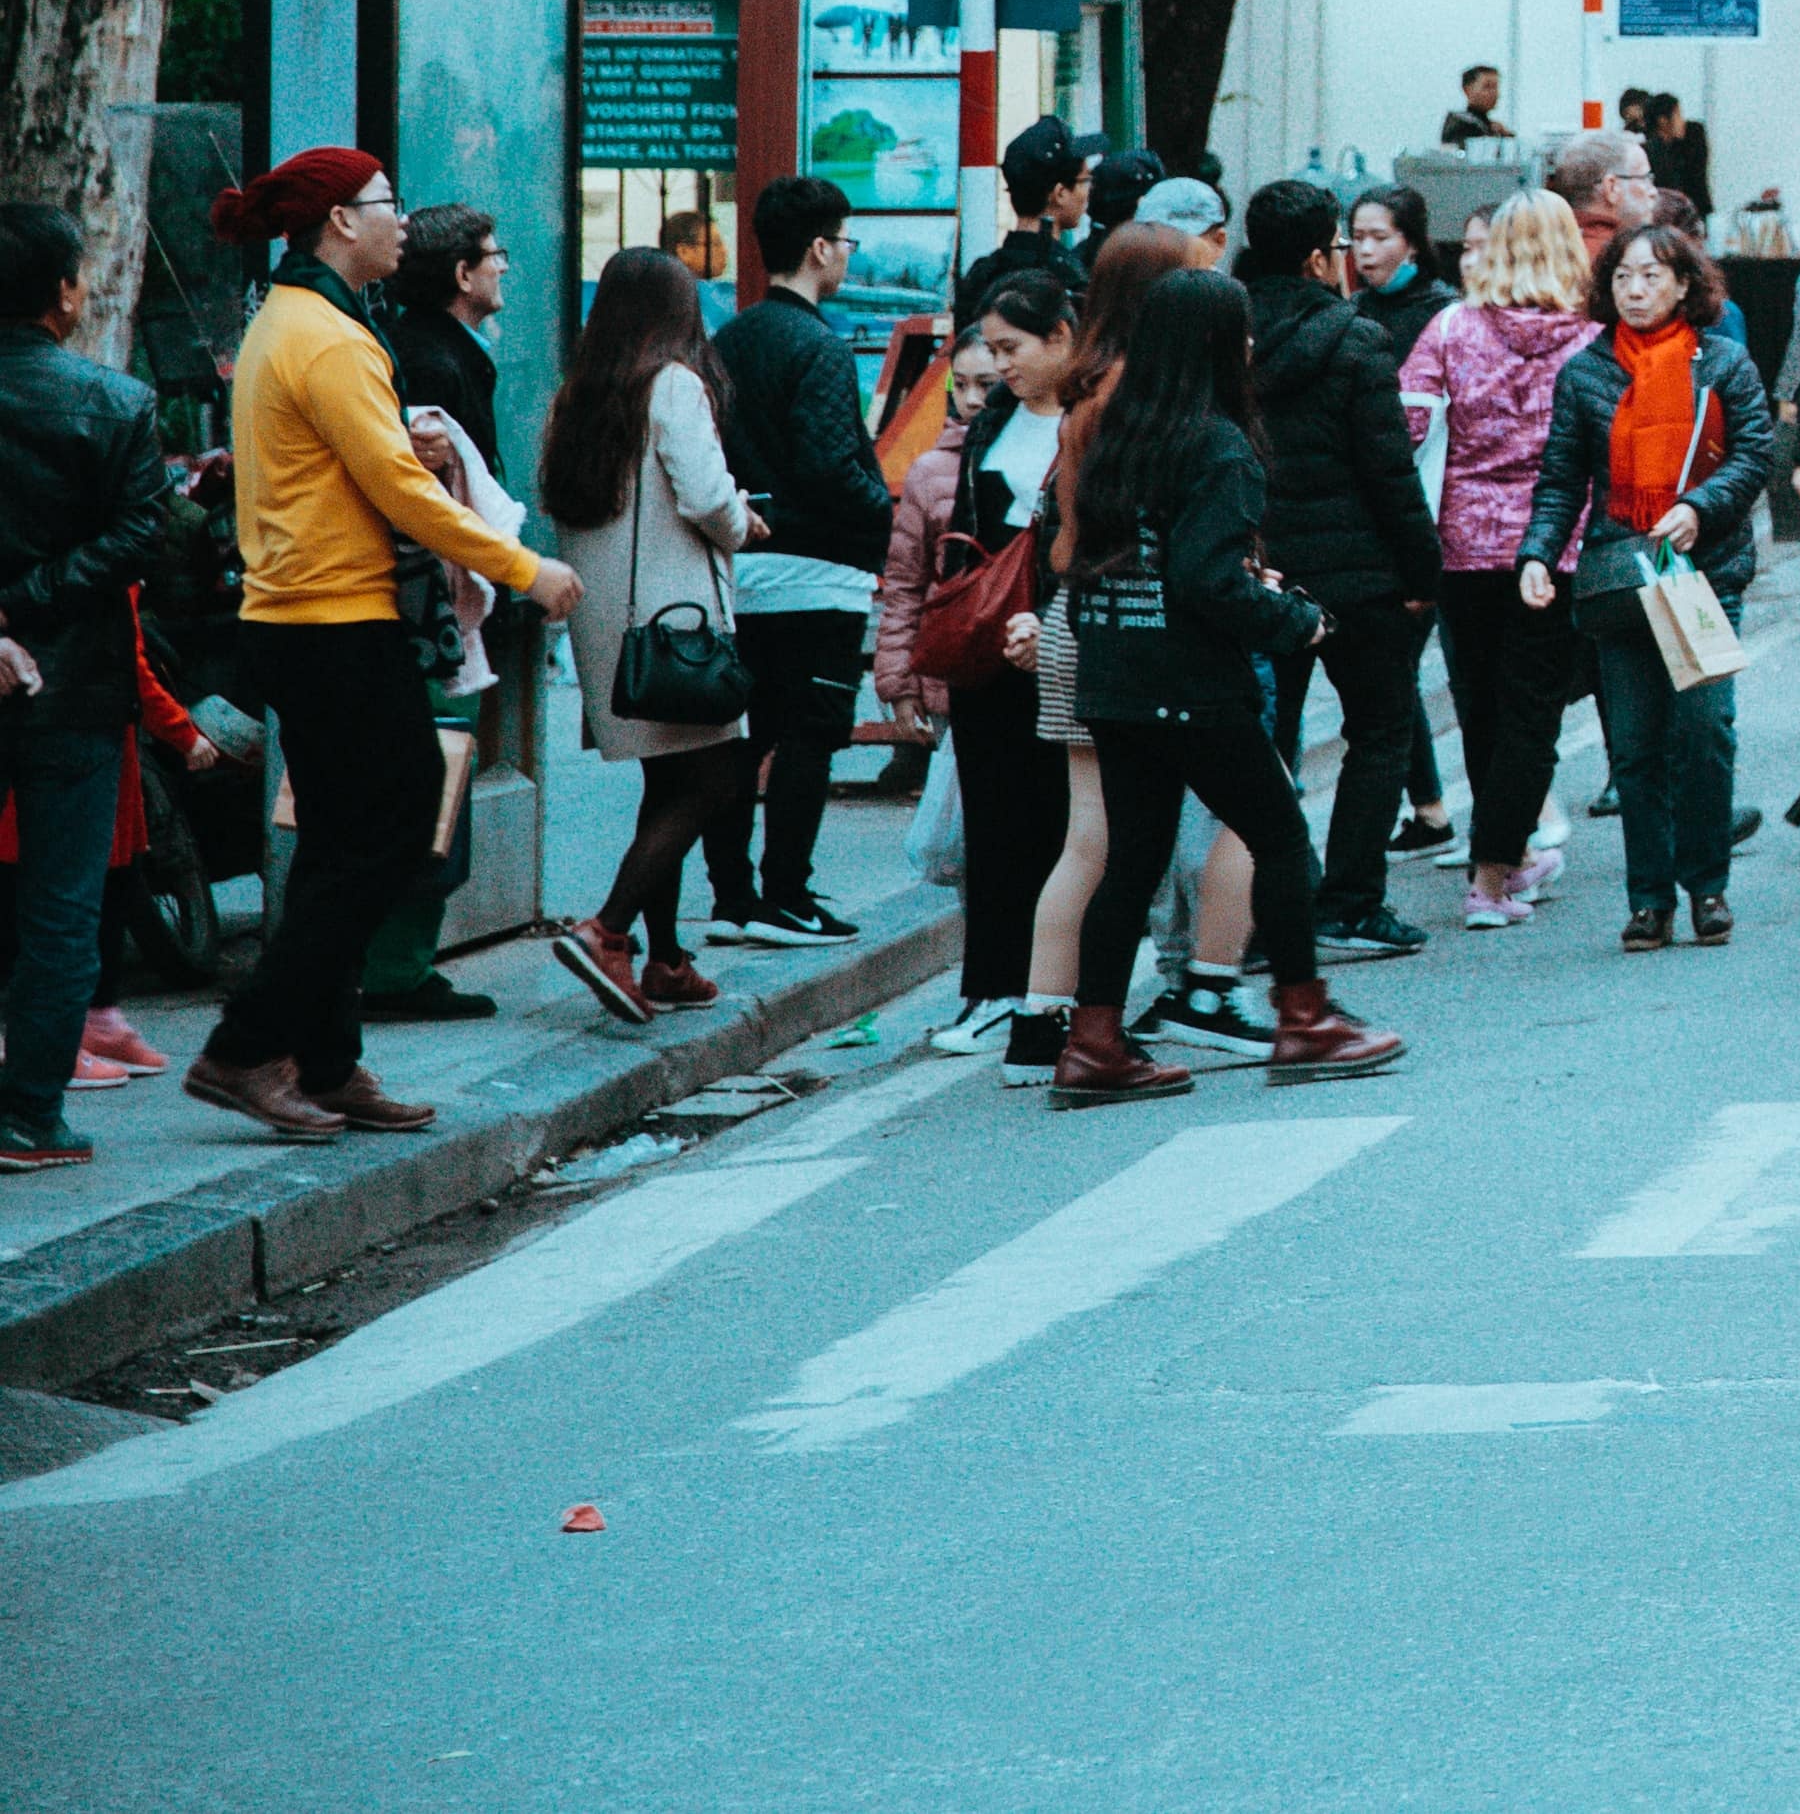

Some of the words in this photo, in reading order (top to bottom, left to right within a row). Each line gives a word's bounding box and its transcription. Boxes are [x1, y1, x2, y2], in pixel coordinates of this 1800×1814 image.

[592, 81, 631, 96] VISIT
[587, 102, 687, 119] VOUCHERS
[584, 123, 686, 140] STAURANTS,
[647, 143, 678, 159] ALL
